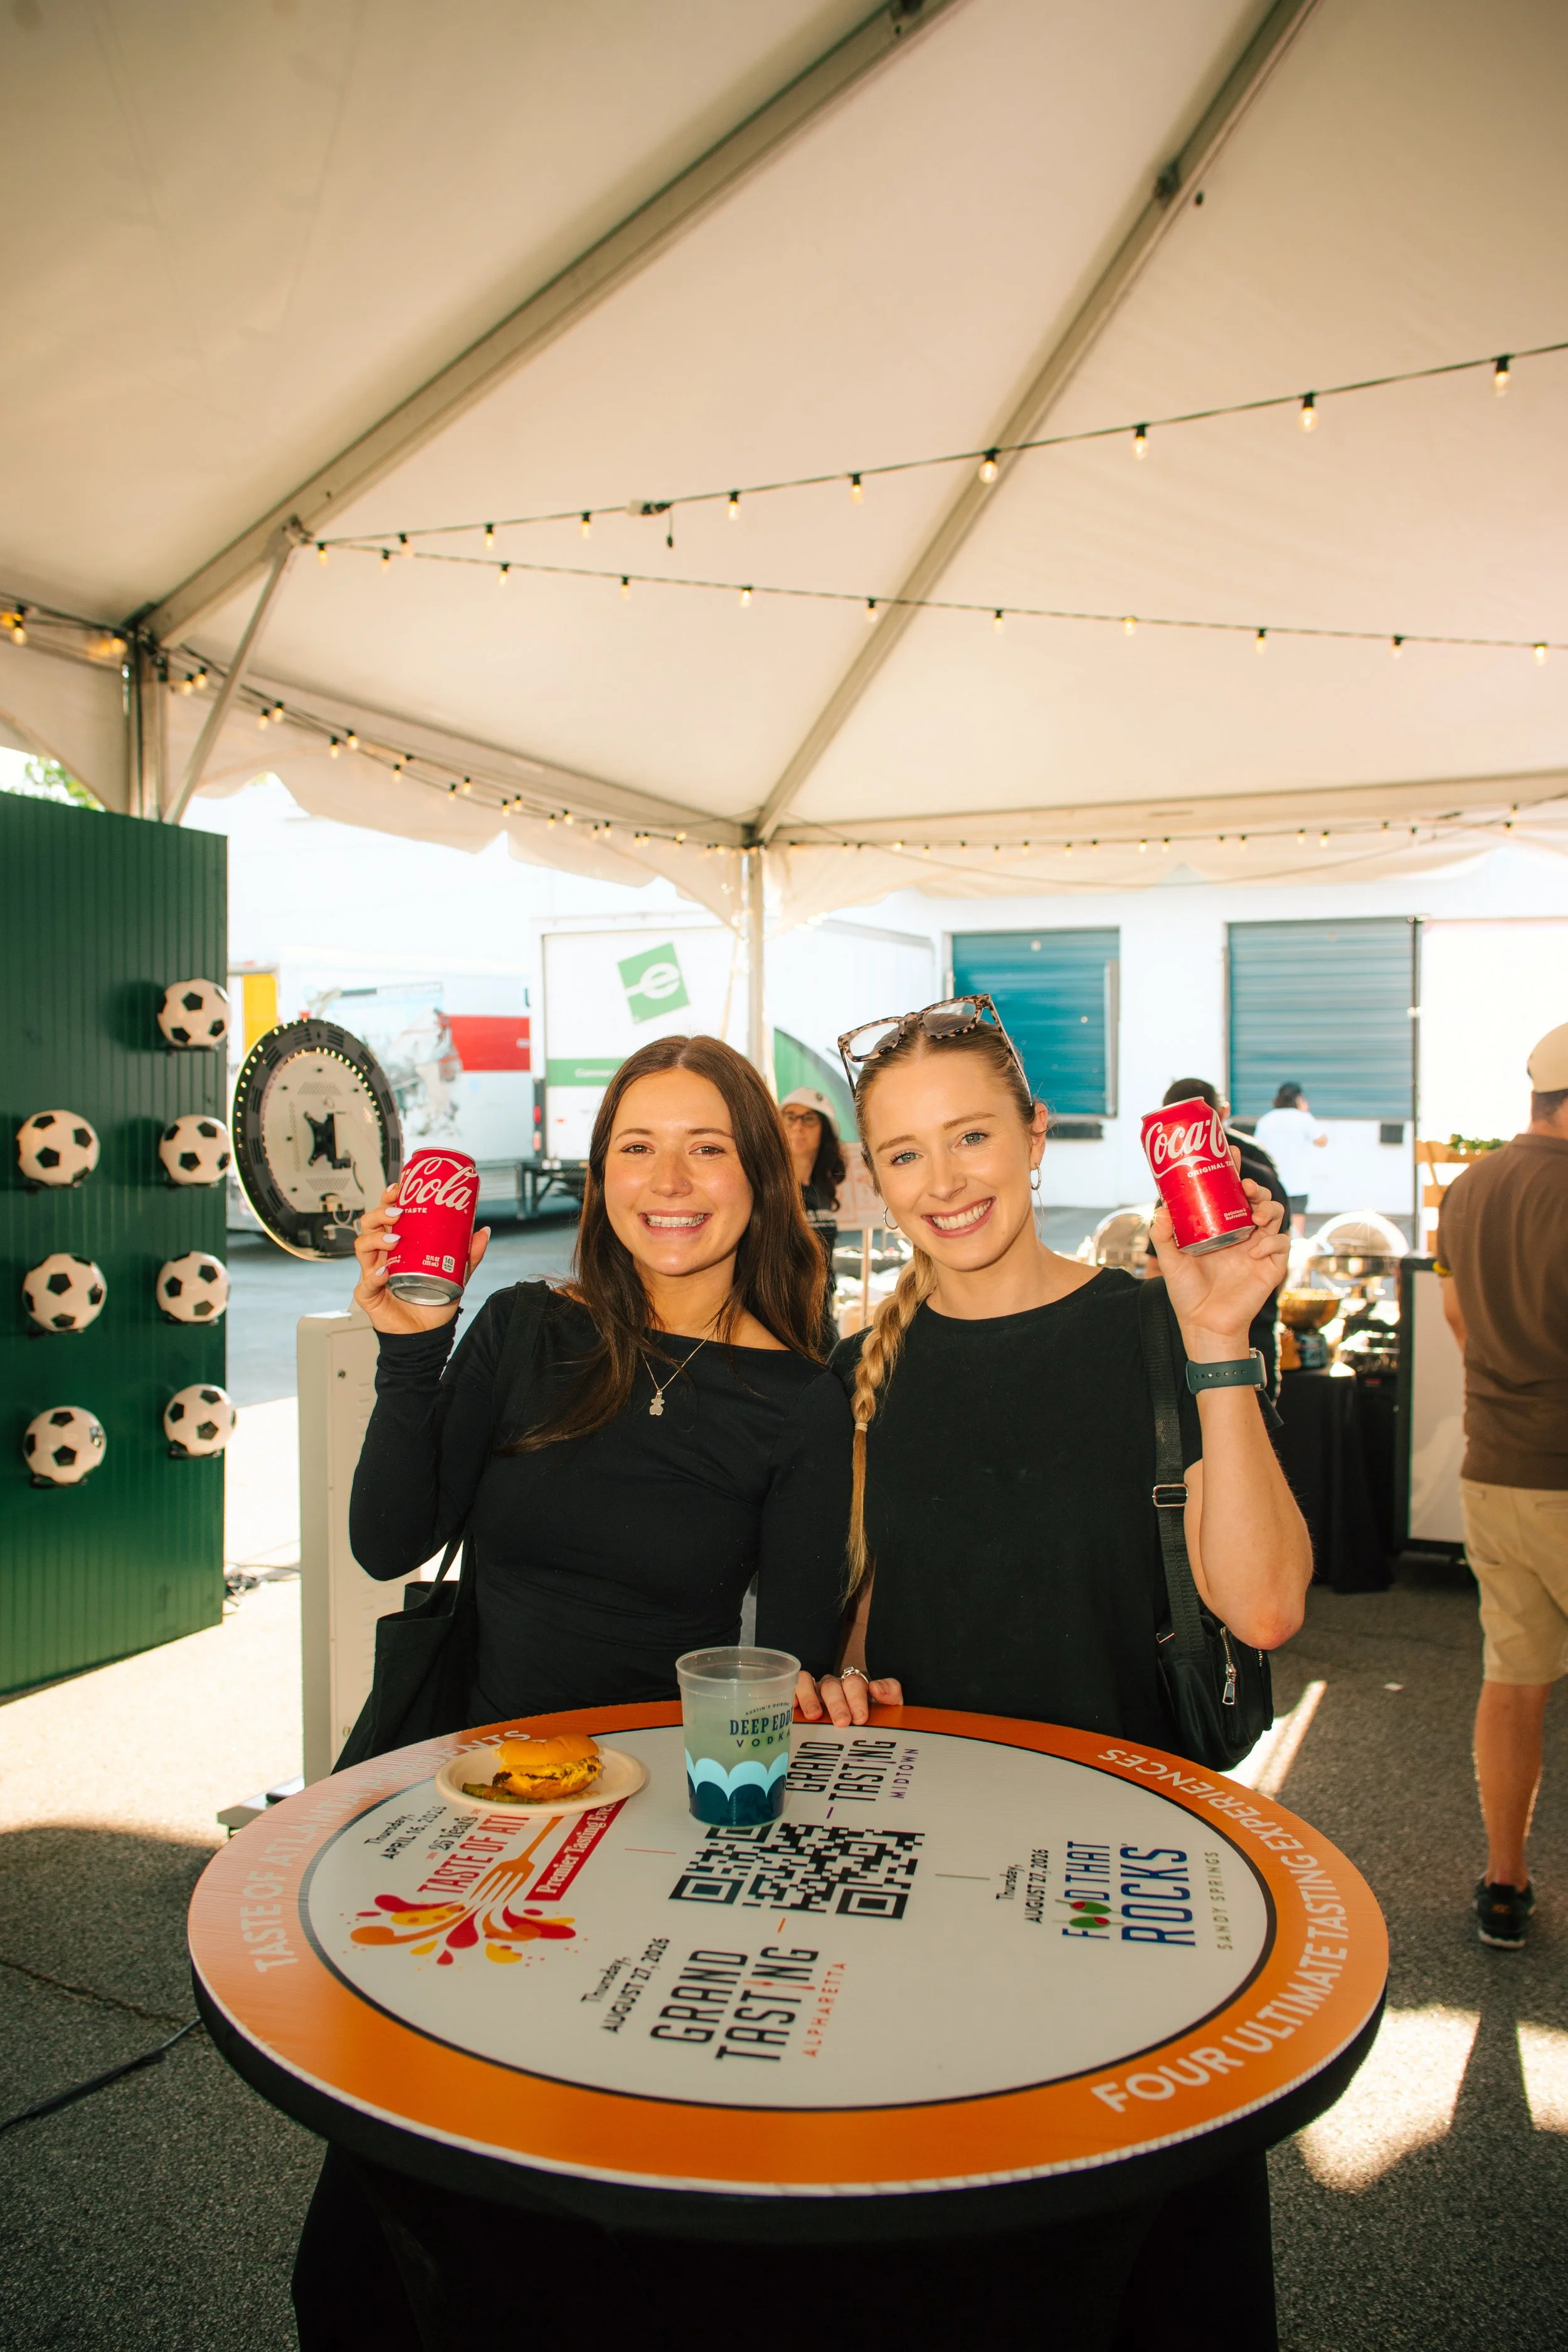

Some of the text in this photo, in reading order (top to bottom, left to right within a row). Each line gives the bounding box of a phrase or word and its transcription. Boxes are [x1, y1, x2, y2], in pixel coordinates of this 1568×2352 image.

[1145, 1111, 1226, 1179] Coca-C
[1187, 1162, 1225, 1178] ORIGINAL
[398, 1157, 477, 1210] -Cola
[1226, 1212, 1248, 1221] Refreshing
[445, 1257, 453, 1266] 140
[729, 1717, 769, 1735] DEEP
[746, 1705, 771, 1716] AUSTIN'S
[785, 1741, 845, 1793] GRAND
[828, 1739, 897, 1801] TASTING
[889, 1748, 920, 1799] MIDTOWN
[259, 1786, 372, 1868] ATLANTA
[364, 1814, 415, 1844] Thursday,
[380, 1836, 416, 1860] APRIL
[417, 1806, 447, 1823] 2026
[416, 1853, 494, 1894] TASTE
[459, 1835, 509, 1853] OF
[535, 1853, 580, 1894] Premier
[563, 1821, 607, 1853] Tasting
[995, 1864, 1025, 1900] Thursday,
[1030, 1848, 1049, 1869] 2026
[1064, 1841, 1110, 1883] THAT
[243, 1870, 286, 1899] OF
[1024, 1883, 1046, 1924] AUGUST
[1120, 1846, 1196, 1947] ROCKS
[1204, 1851, 1234, 1951] SANDY SPRINGS
[240, 1904, 300, 1973] TASTE
[1091, 1749, 1349, 2113] FOUR ULTIMATE TASTING EXPERIENCES
[581, 1956, 632, 2002] Thursday,
[601, 1982, 644, 2034] AUGUST
[640, 1937, 670, 1963] 2026
[650, 1949, 748, 2043] GRAND
[715, 1946, 820, 2060] TASTING
[802, 1962, 847, 2058] ALPHARETTA
